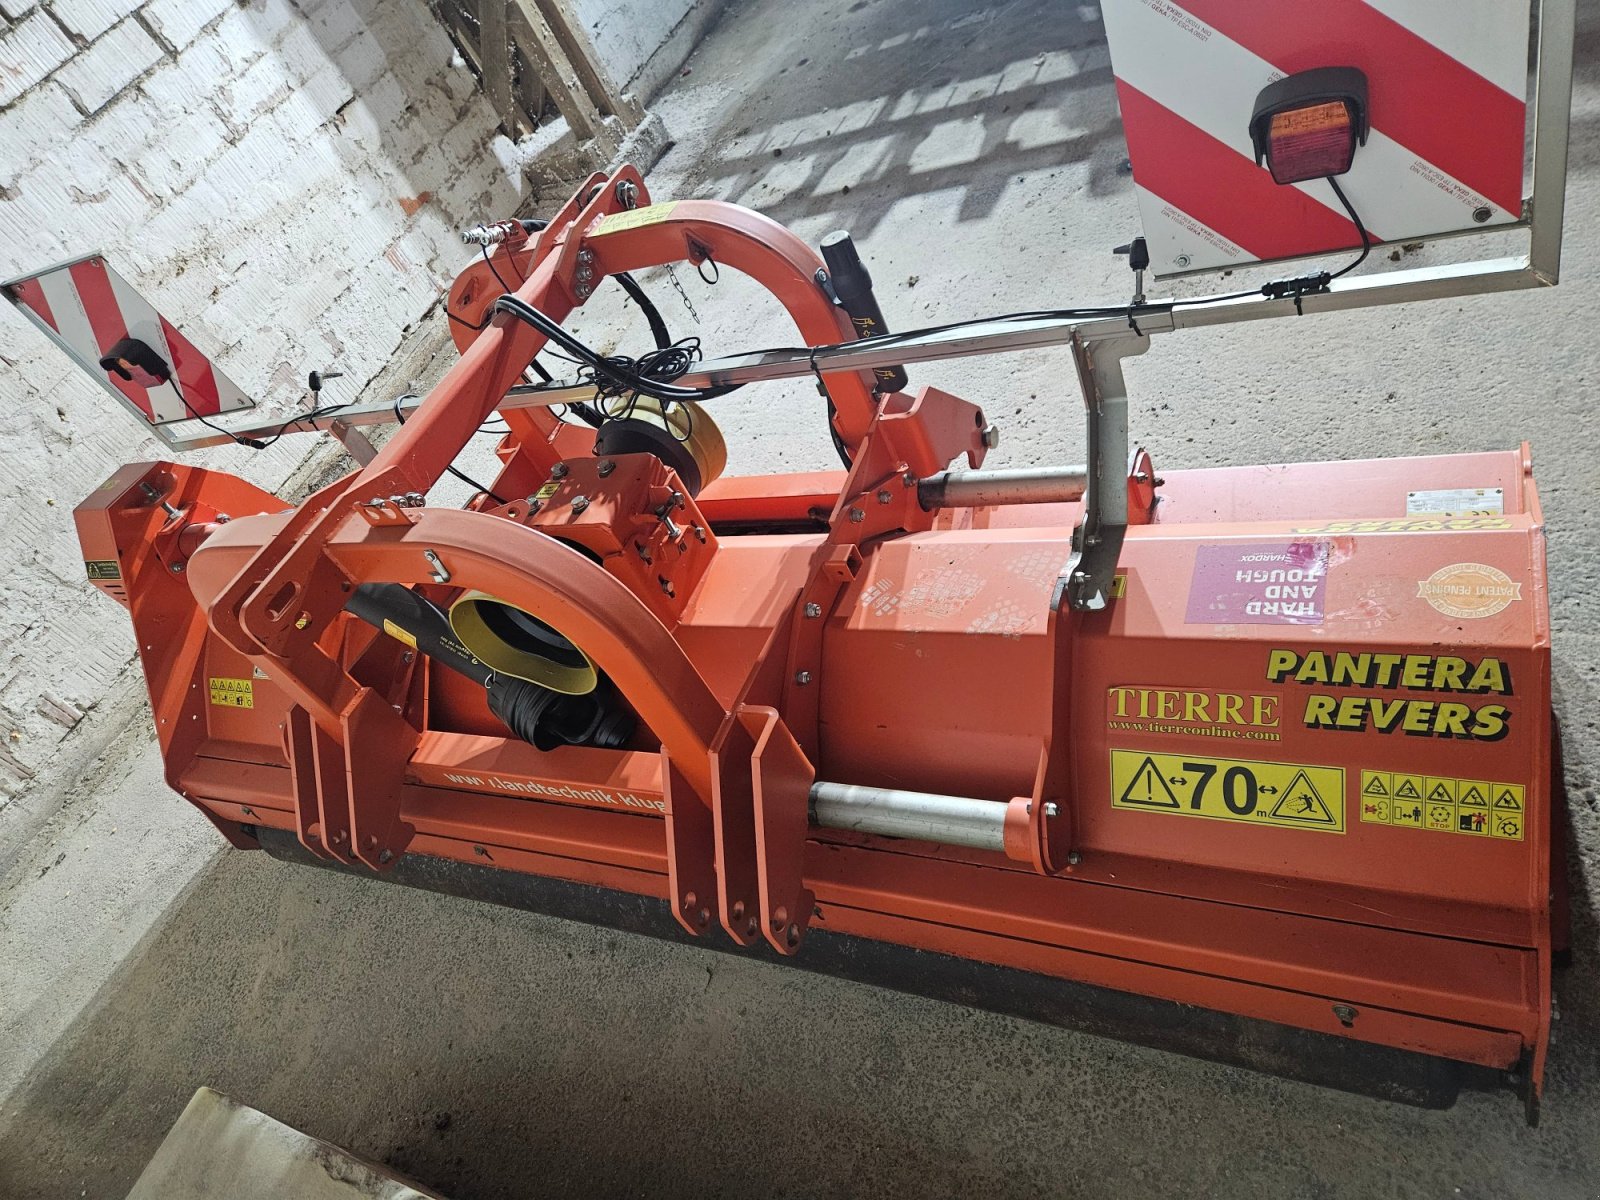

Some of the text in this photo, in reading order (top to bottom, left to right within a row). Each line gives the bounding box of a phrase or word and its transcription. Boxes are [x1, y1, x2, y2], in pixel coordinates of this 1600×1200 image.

[1236, 569, 1319, 583] TOUGH
[1265, 585, 1318, 599] AND
[1425, 584, 1514, 596] PATENT PENDING
[1246, 602, 1315, 616] HARD
[1266, 650, 1512, 694] PANTERA
[1109, 688, 1281, 727] TIERRE
[1303, 695, 1511, 740] REVERS
[1108, 720, 1281, 741] www.tierreonline.com
[1182, 762, 1258, 816] 70
